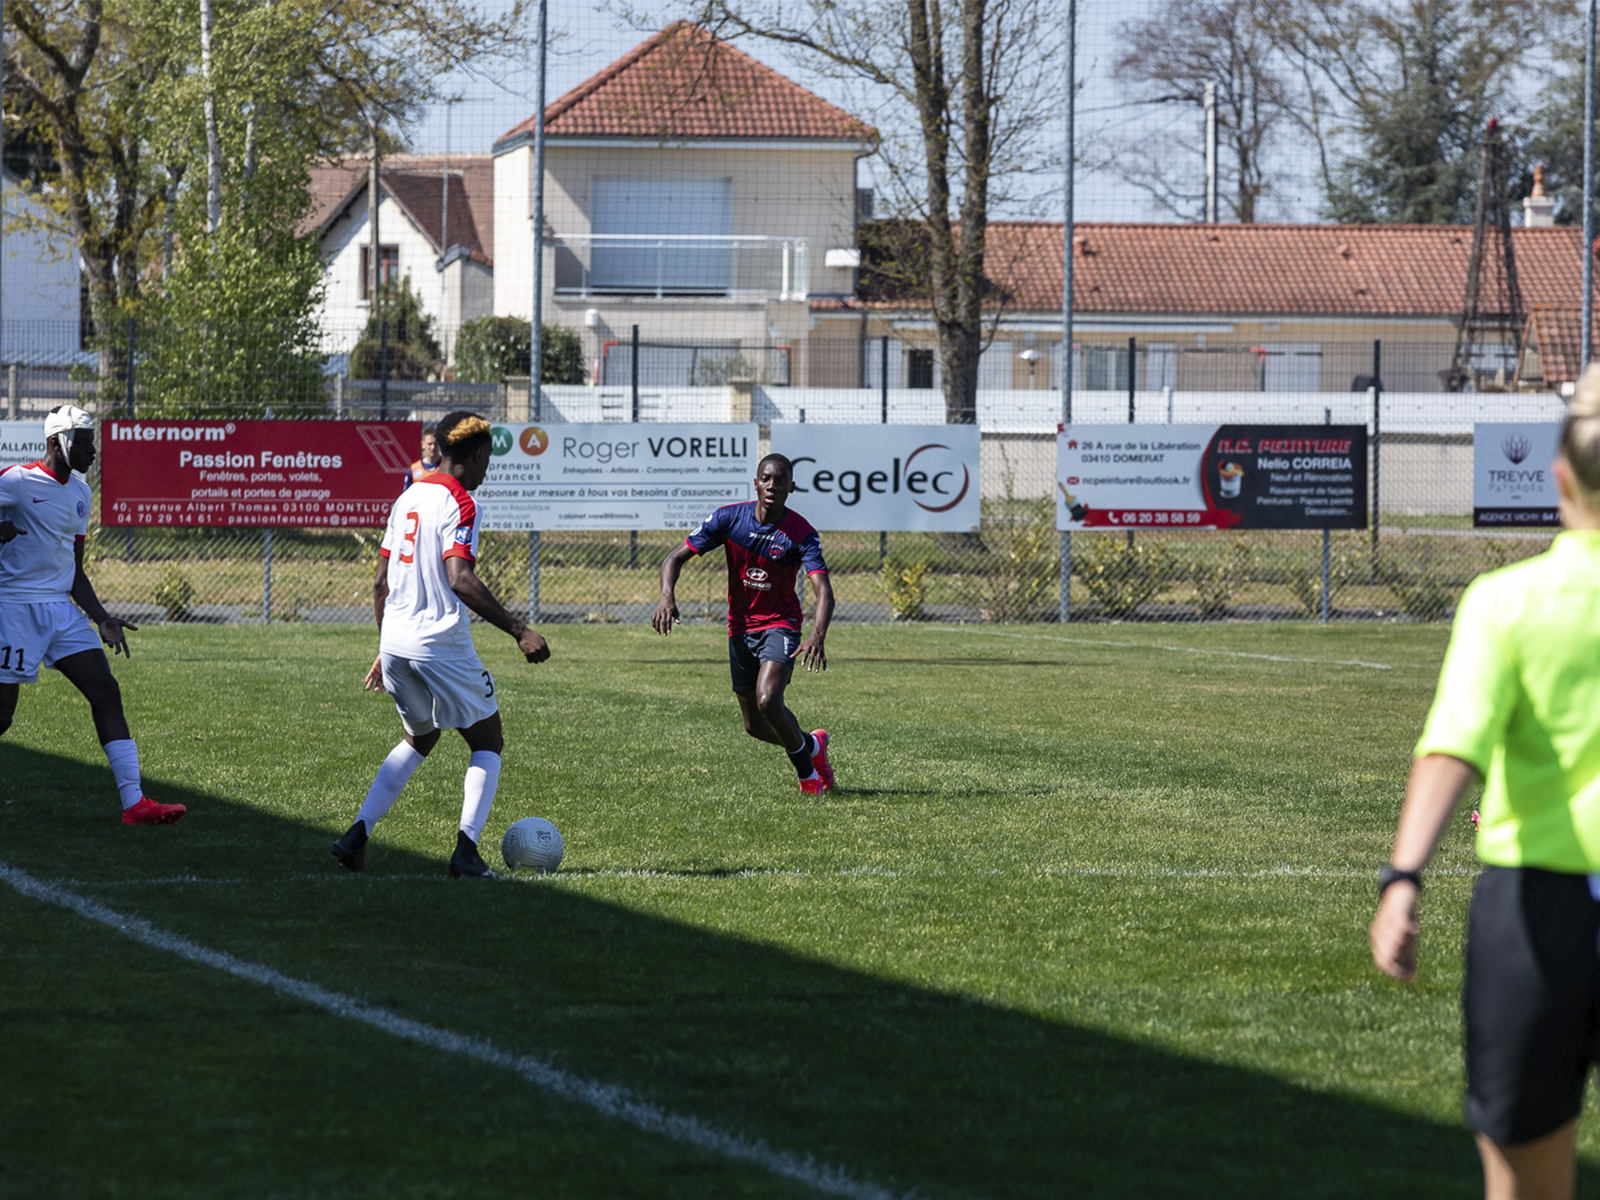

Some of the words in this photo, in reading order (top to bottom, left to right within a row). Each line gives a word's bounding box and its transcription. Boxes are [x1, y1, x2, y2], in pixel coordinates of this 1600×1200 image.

[0, 442, 46, 452] ALLATIO
[526, 433, 542, 449] A
[1096, 440, 1103, 450] A
[1106, 442, 1122, 450] rue
[1124, 440, 1136, 450] de
[1139, 440, 1149, 450] la
[1151, 440, 1200, 450] Libération
[1257, 439, 1352, 454] PEINTURE
[563, 437, 640, 464] Roger
[647, 436, 747, 458] VORELLI
[179, 450, 255, 468] Passion
[260, 450, 343, 468] Fenêtres
[1081, 454, 1111, 463] 03410
[1113, 454, 1164, 463] DOMERAT
[1257, 457, 1290, 470] Nelio
[1292, 457, 1352, 470] CORREIA
[200, 470, 248, 483] Fenêtres,
[251, 471, 286, 484] portes,
[289, 471, 322, 483] volets,
[646, 467, 700, 475] Commerçants
[1270, 472, 1292, 482] Neuf
[1293, 472, 1302, 482] et
[1488, 470, 1545, 482] TREYVE
[791, 456, 954, 507] Cegelec
[191, 487, 229, 500] portails
[231, 487, 242, 498] et
[244, 488, 276, 500] portes
[278, 487, 292, 498] de
[294, 489, 331, 500] garage
[477, 487, 519, 498] réponse
[522, 489, 536, 497] sur
[538, 489, 576, 497] mesure
[578, 486, 586, 497] à
[587, 487, 609, 497] tous
[612, 489, 628, 497] vos
[630, 487, 668, 497] besoins
[112, 502, 132, 513] 40,
[137, 503, 182, 512] avenue
[186, 502, 225, 512] Albert
[230, 502, 277, 512] Thomas
[282, 502, 320, 513] 03100
[117, 514, 132, 524] 04
[138, 514, 152, 524] 70
[157, 514, 173, 524] 29
[179, 514, 192, 524] 14
[198, 514, 212, 524] 61
[1122, 512, 1136, 523] 06
[1138, 512, 1152, 523] 20
[399, 511, 419, 564] 3
[0, 645, 25, 672] 11
[481, 670, 494, 698] 3
